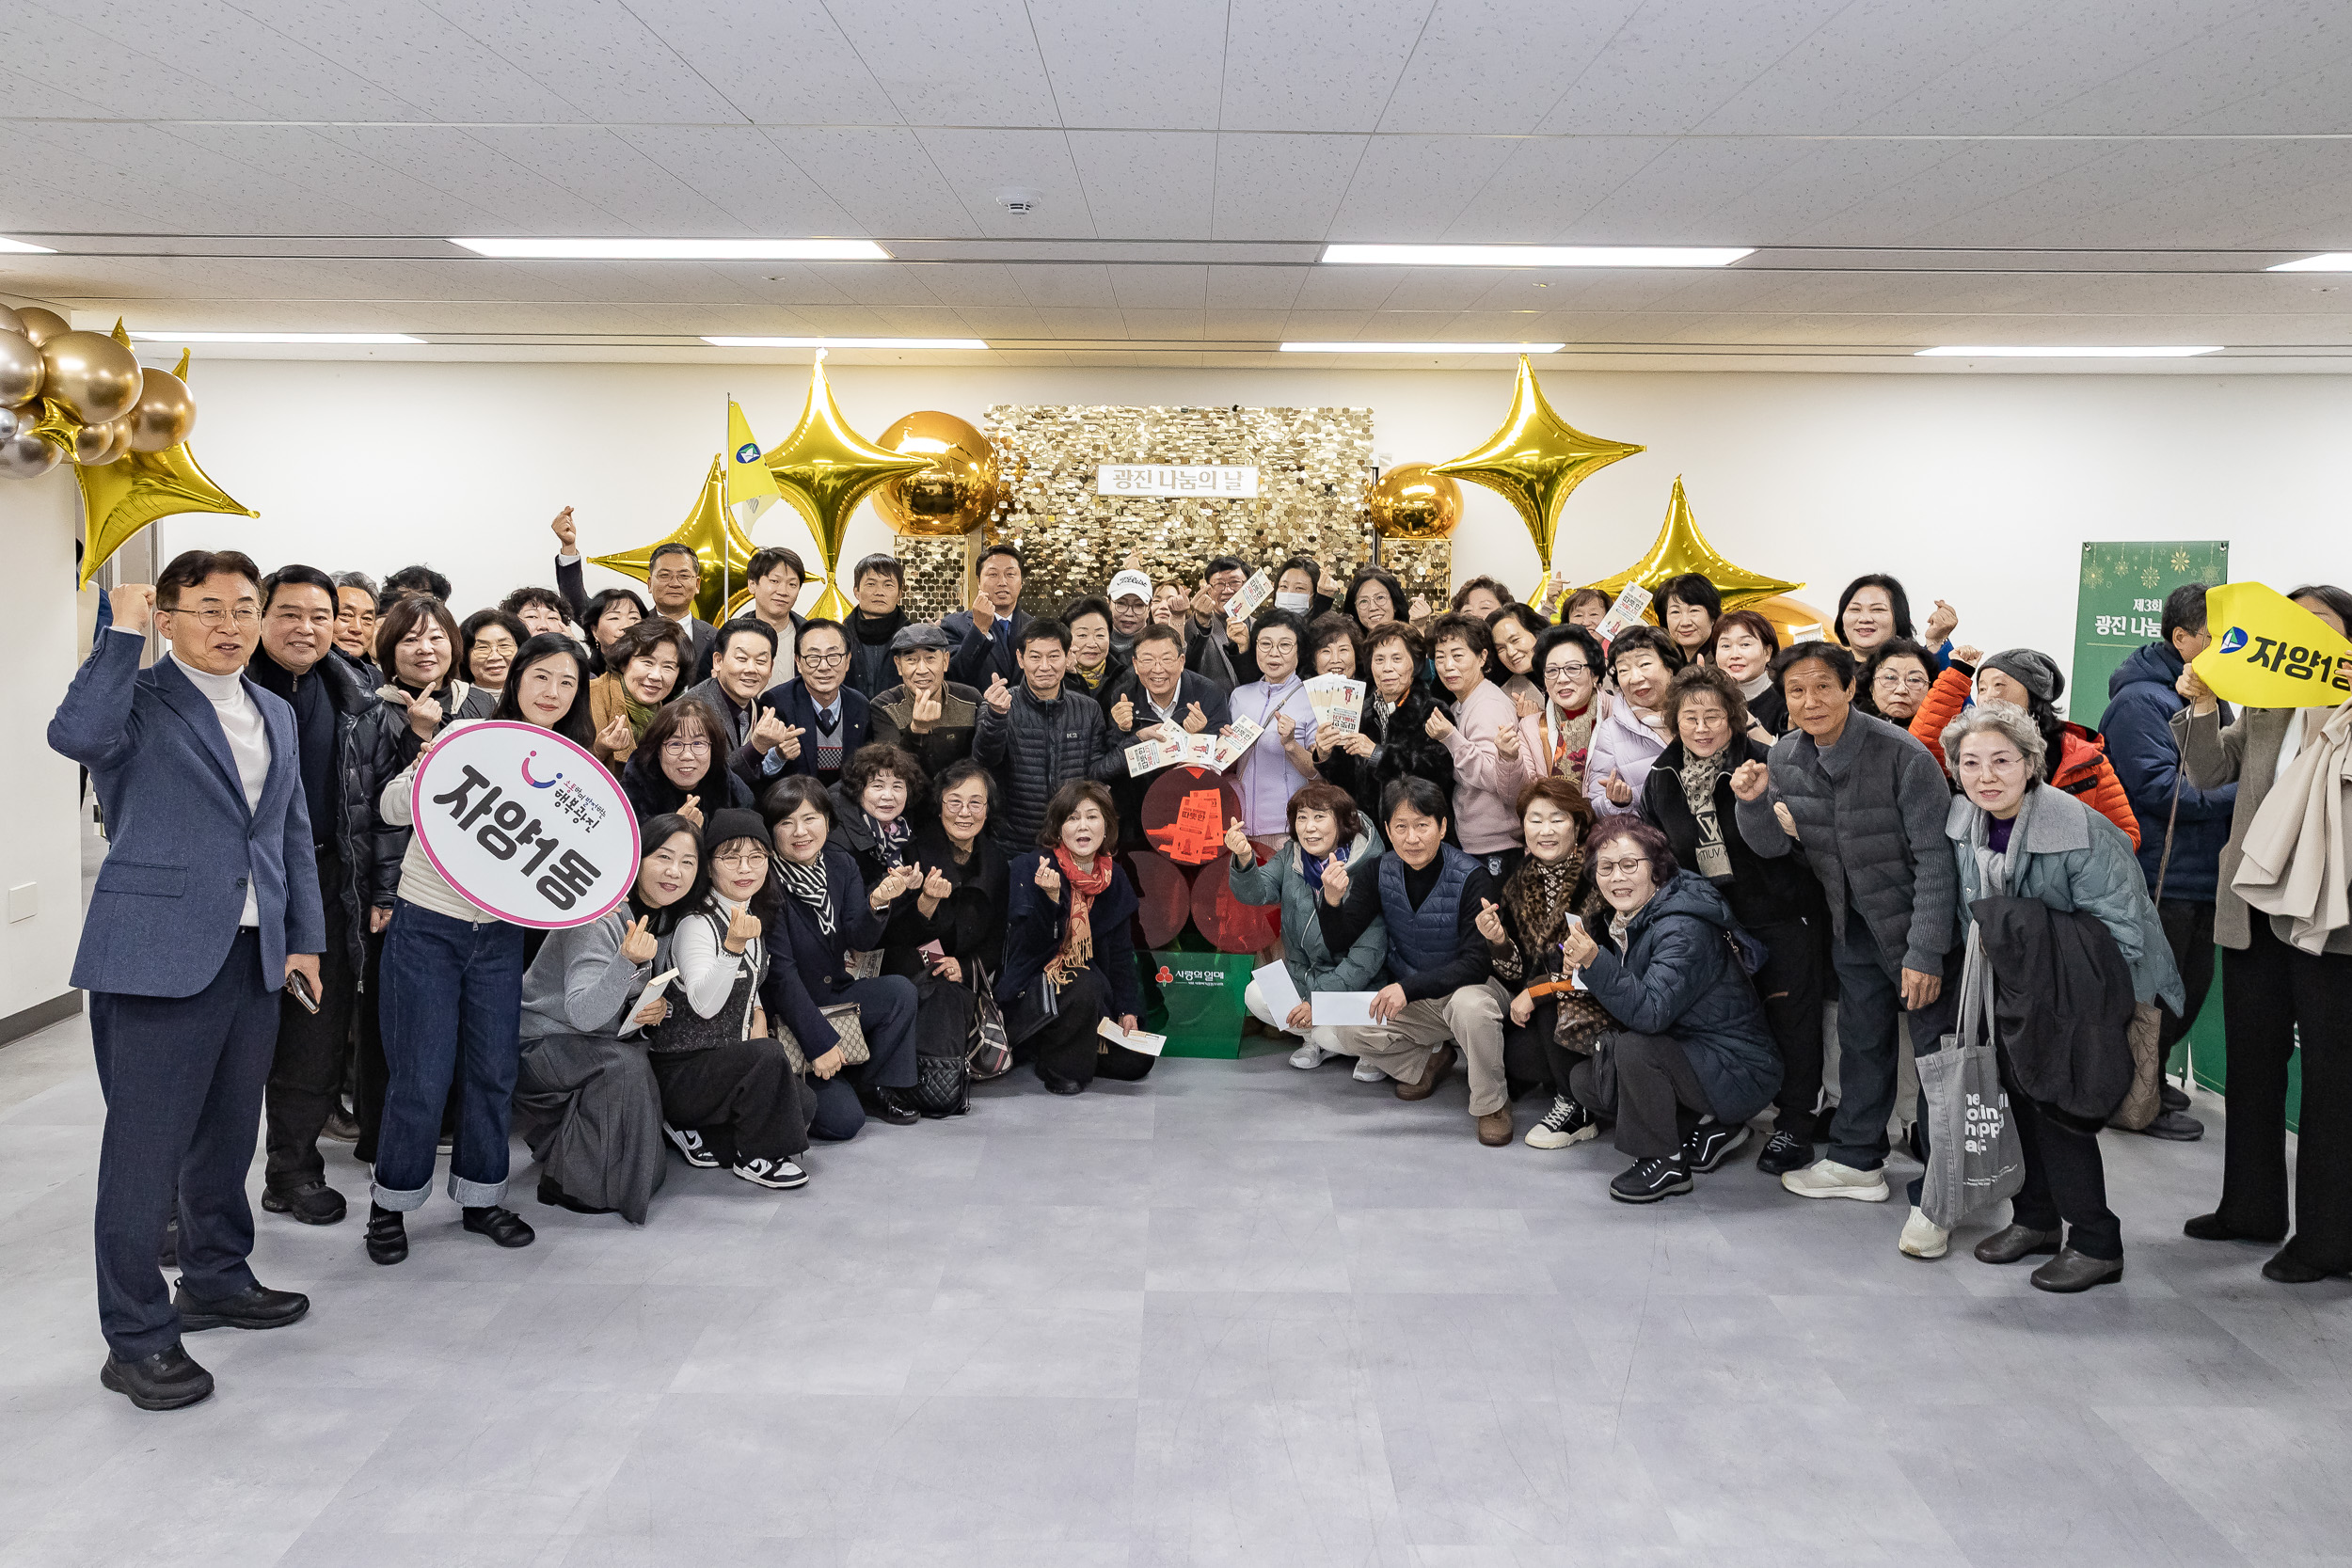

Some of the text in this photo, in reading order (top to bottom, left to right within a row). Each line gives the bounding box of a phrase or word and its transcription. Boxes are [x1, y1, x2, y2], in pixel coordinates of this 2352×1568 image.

[1113, 469, 1244, 491] 광진 나눔의 날
[2133, 598, 2163, 613] 제3회
[2094, 615, 2127, 636] 광진
[564, 780, 586, 800] 소통하며
[554, 788, 600, 833] 행복광진
[433, 764, 602, 911] 자양1동
[1175, 970, 1224, 981] 사랑의 열매
